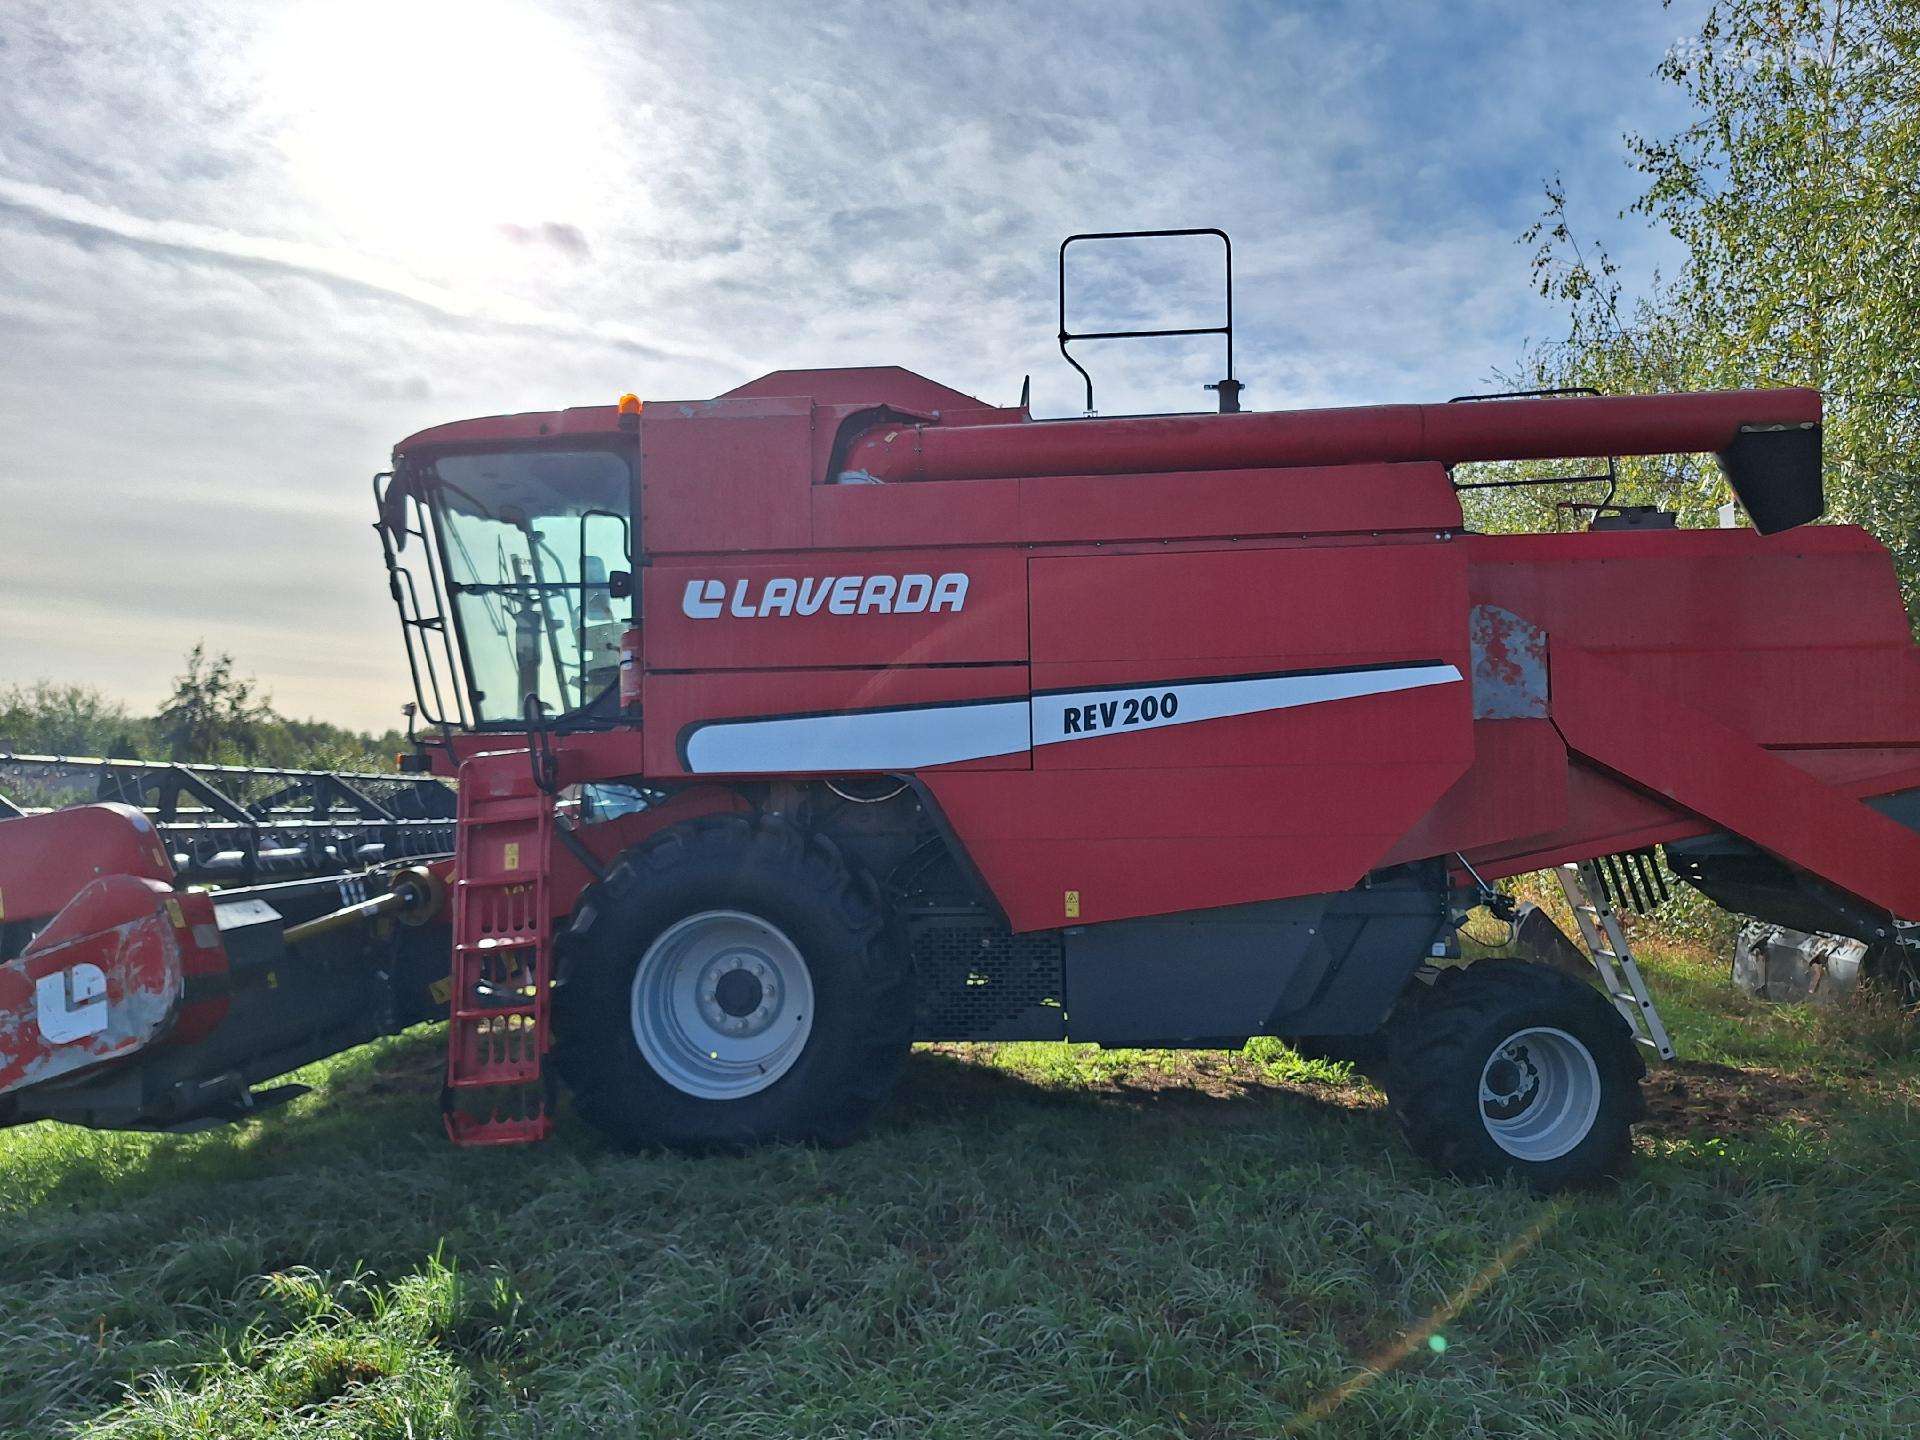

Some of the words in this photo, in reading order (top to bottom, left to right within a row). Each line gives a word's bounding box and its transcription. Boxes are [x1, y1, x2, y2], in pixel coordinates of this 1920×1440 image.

[731, 572, 970, 618] LAVERDA
[1063, 700, 1119, 735] REV
[1122, 692, 1179, 726] 200
